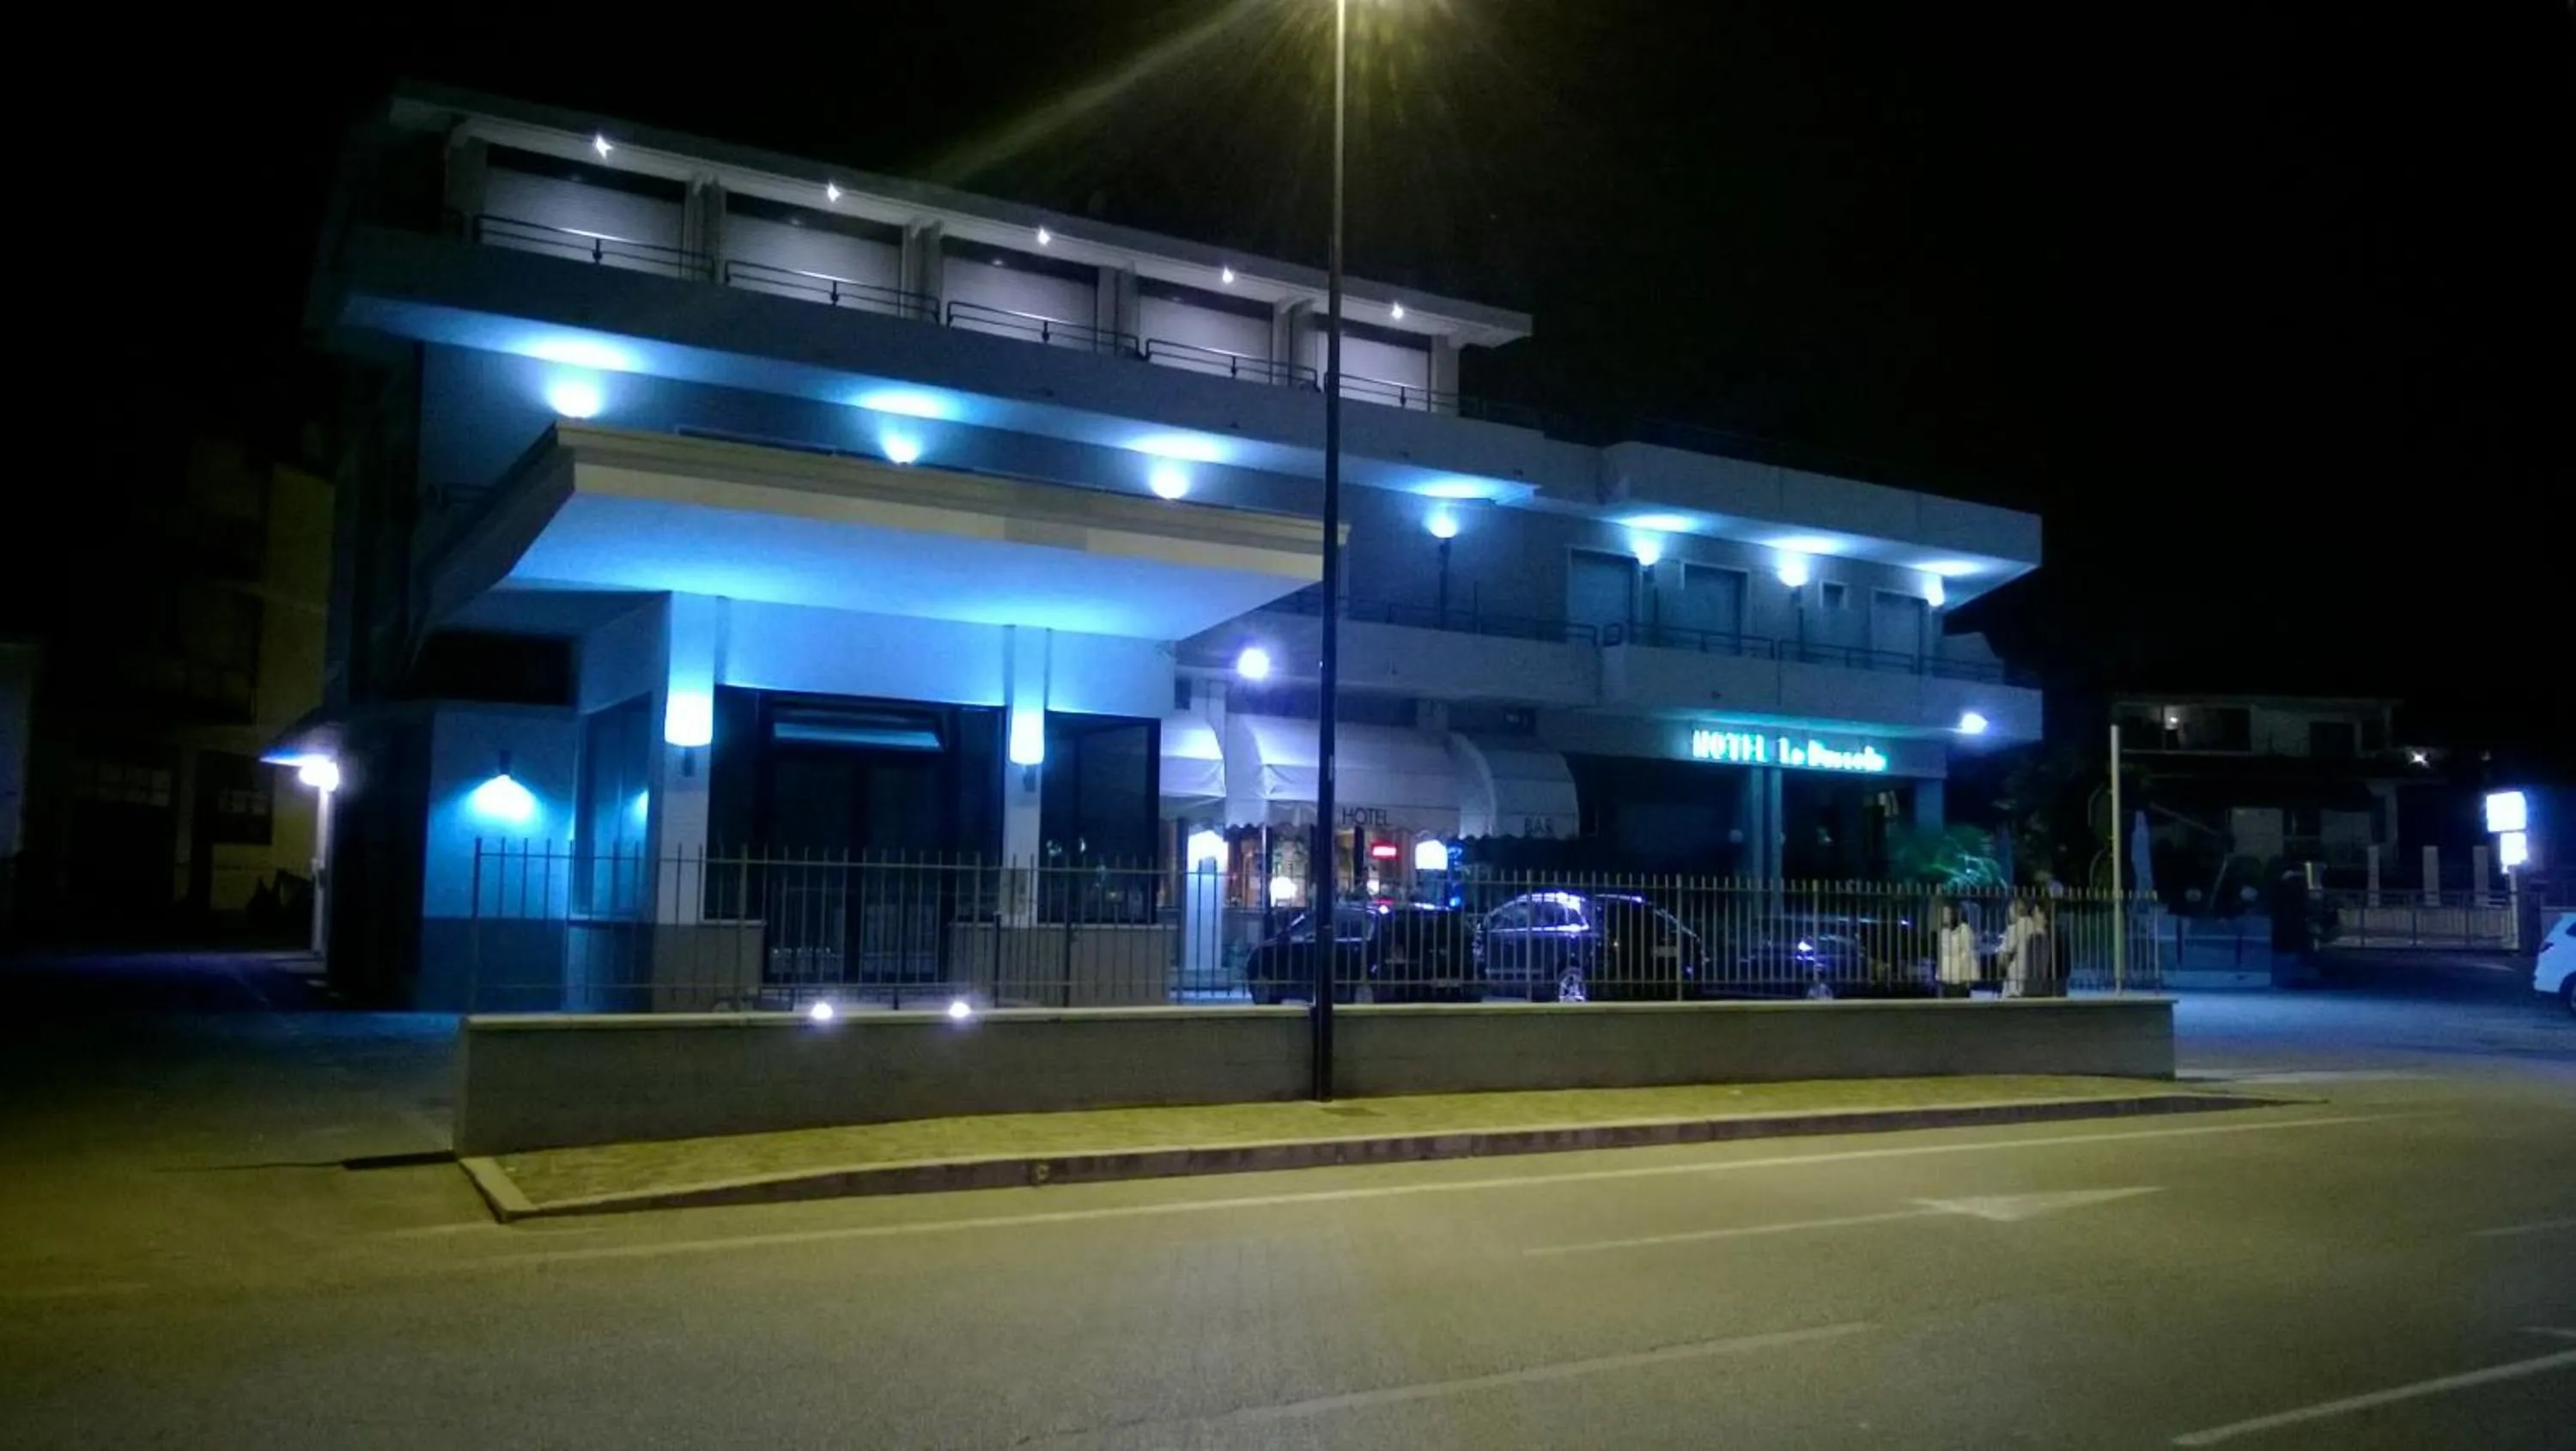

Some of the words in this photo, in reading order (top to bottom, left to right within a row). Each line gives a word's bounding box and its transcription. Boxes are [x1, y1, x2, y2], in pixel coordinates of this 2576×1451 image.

[1692, 730, 1767, 762] HOTEL
[1341, 806, 1389, 827] HOTEL
[1524, 817, 1553, 834] BAR
